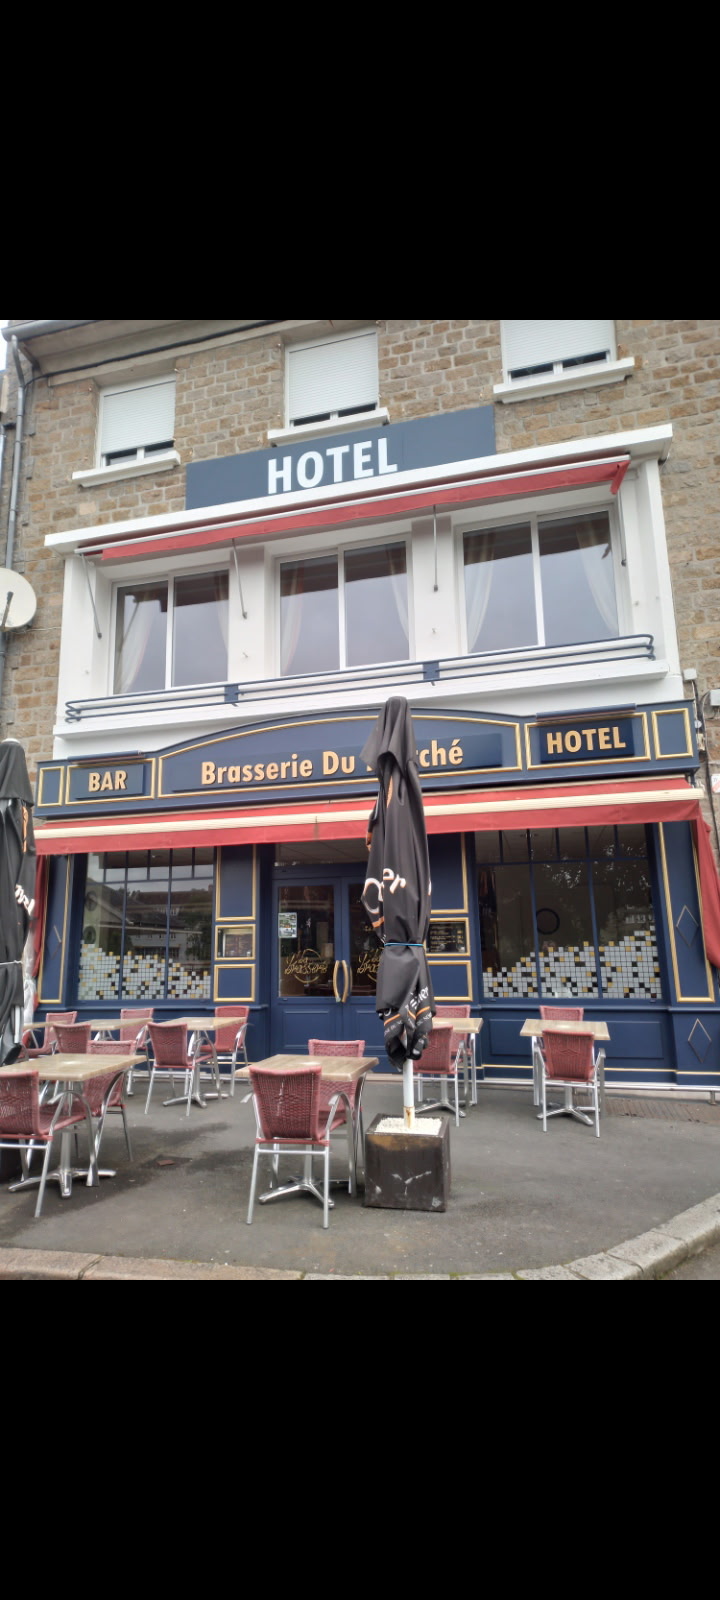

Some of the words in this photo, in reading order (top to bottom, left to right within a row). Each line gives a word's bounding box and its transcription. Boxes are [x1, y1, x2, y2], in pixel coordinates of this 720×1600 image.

[267, 437, 398, 495] HOTEL
[546, 726, 627, 754] HOTEL
[88, 770, 128, 792] BAR
[201, 753, 313, 785] Brasserie
[322, 750, 355, 776] Du
